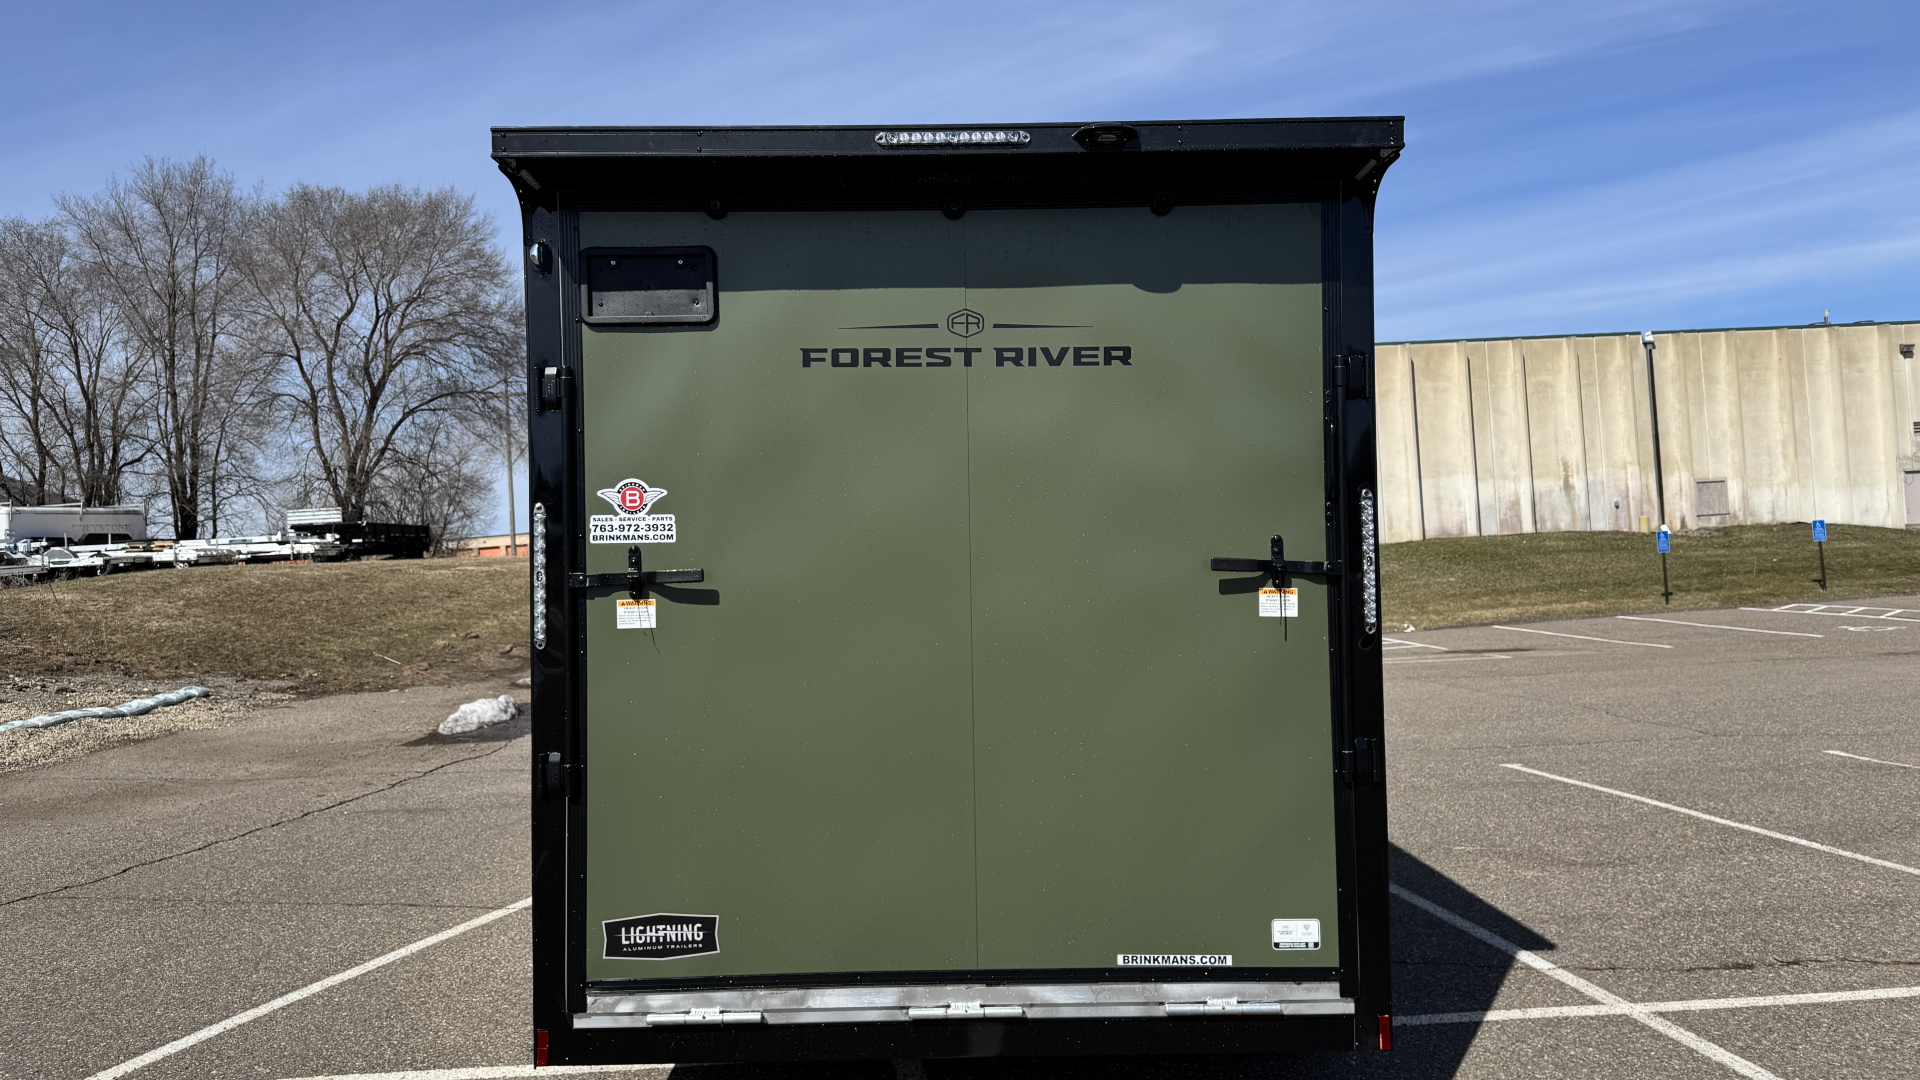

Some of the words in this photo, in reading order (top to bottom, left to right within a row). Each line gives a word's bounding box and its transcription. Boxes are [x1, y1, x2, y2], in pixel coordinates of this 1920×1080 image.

[799, 347, 982, 368] FOREST
[993, 346, 1133, 367] RIVER
[626, 490, 640, 506] B
[592, 524, 674, 532] 763-972-3932
[621, 923, 703, 945] LIGHTNING
[1122, 955, 1227, 965] BRINKMANS.COM
